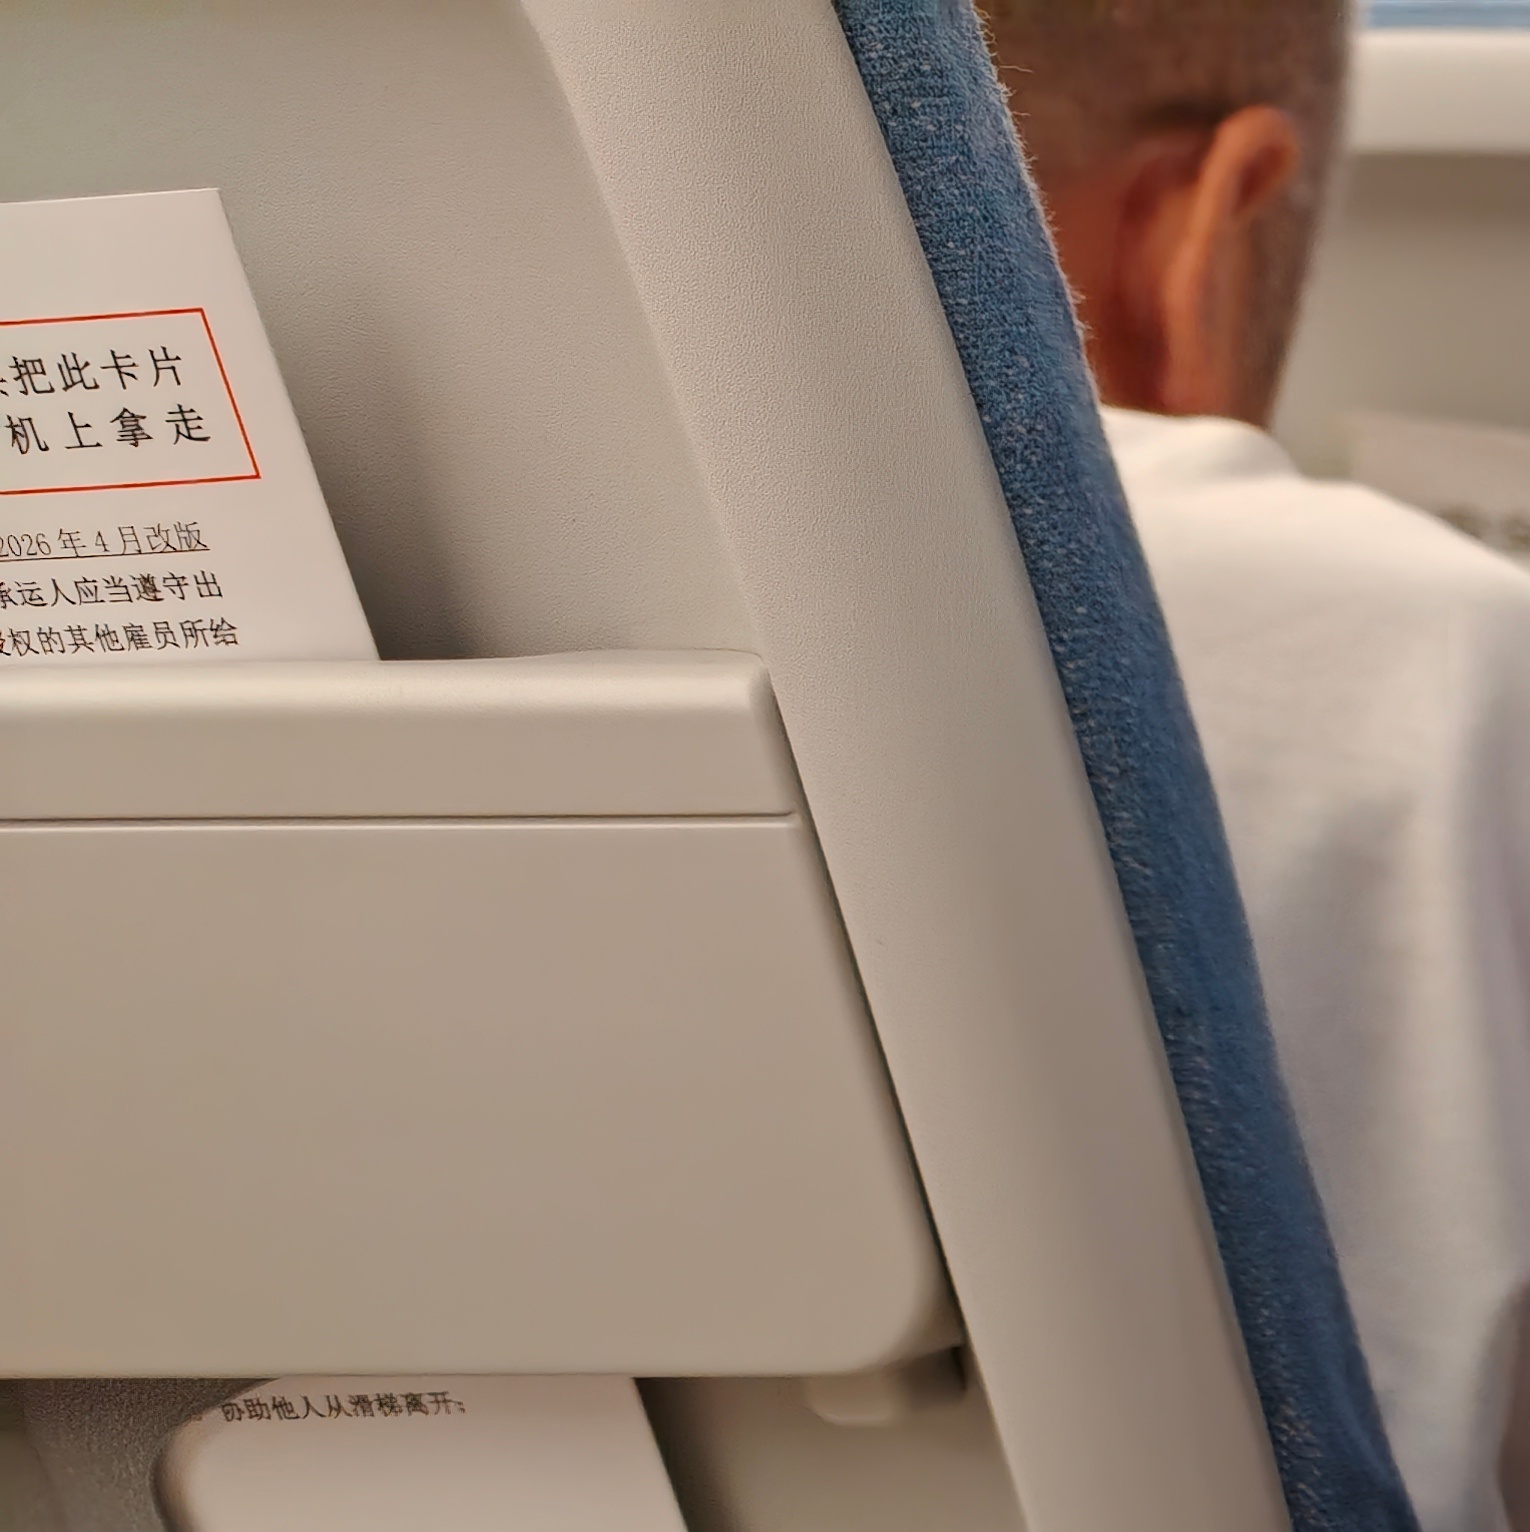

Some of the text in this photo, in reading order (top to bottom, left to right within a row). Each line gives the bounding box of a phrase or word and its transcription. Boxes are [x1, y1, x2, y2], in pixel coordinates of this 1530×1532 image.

[0, 346, 183, 397] 把此卡片
[4, 404, 211, 455] 机上拿走
